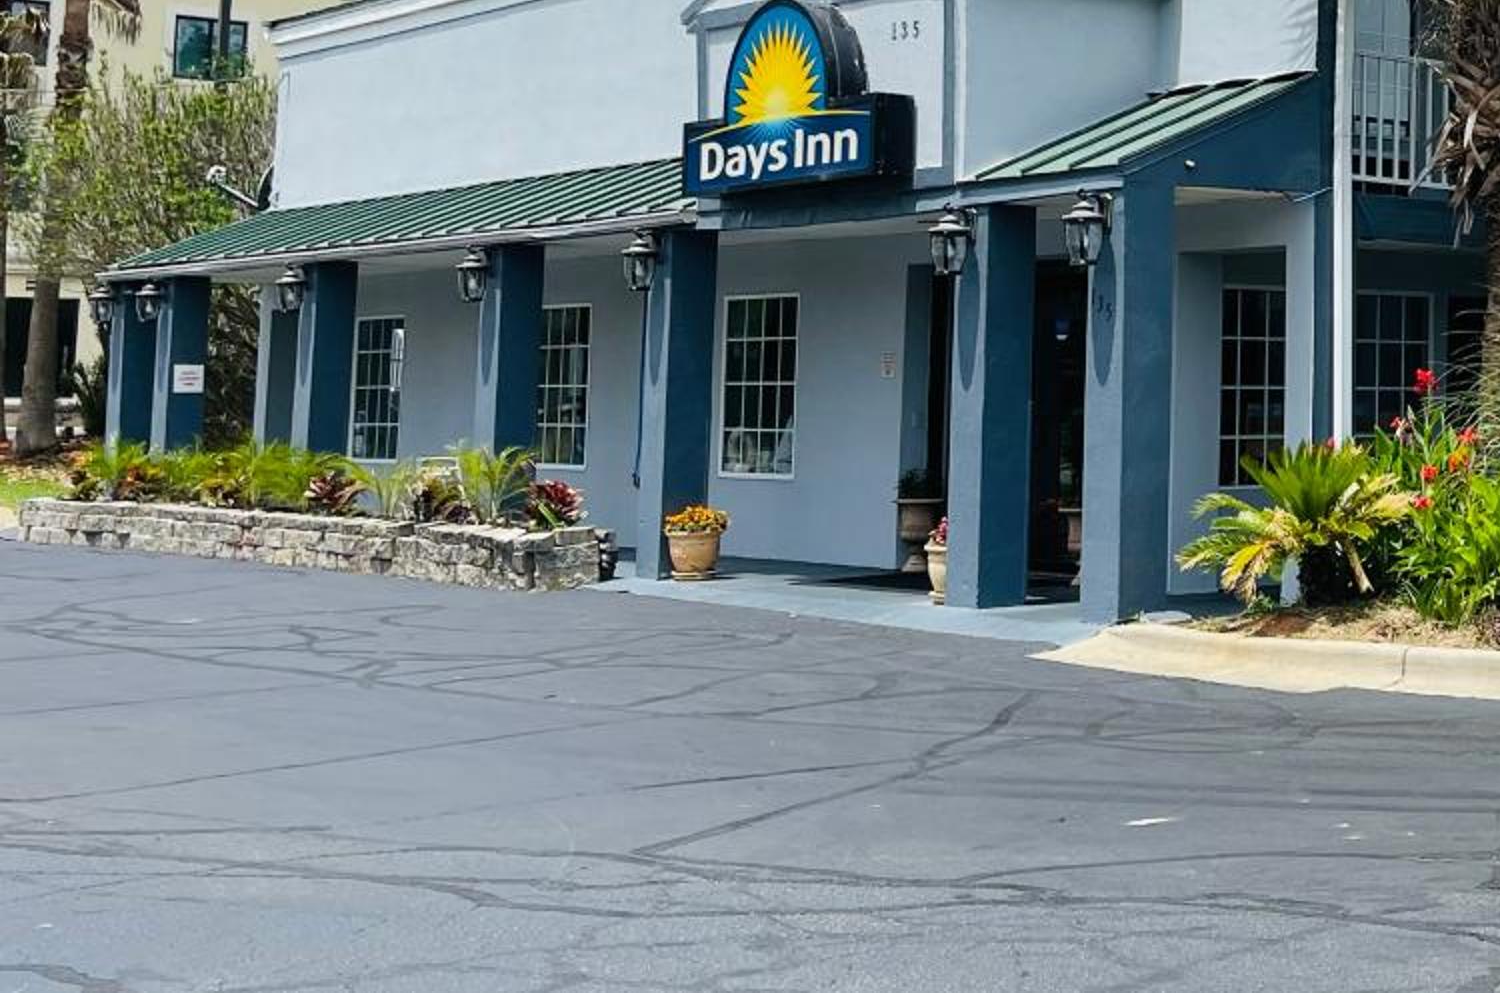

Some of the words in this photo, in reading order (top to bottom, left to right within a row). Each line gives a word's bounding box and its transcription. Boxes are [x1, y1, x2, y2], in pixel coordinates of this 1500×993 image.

[890, 20, 920, 41] 135
[700, 138, 788, 181] Days
[794, 128, 858, 168] Inn
